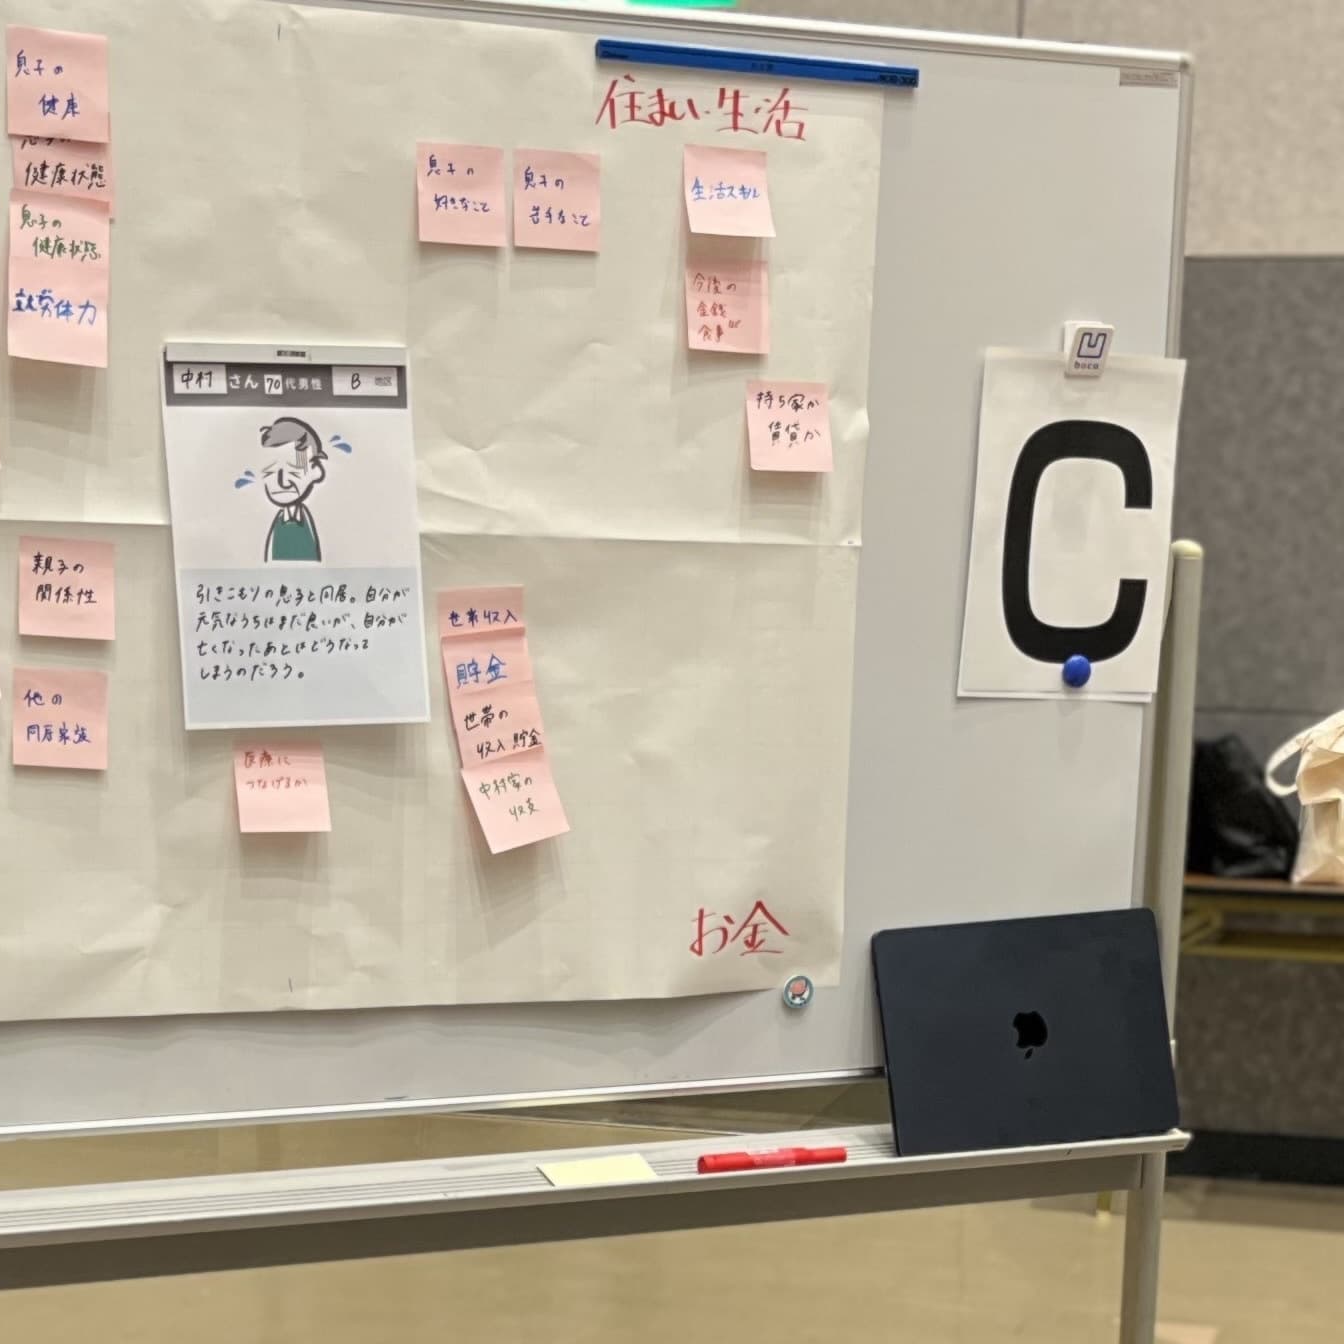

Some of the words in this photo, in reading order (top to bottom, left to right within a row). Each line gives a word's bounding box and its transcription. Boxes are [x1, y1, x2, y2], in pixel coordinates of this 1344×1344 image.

[15, 49, 63, 77] 息子の
[39, 92, 80, 120] 健康
[25, 160, 106, 190] 健康状態
[427, 154, 474, 176] 息子の
[524, 166, 564, 190] 息子の
[691, 176, 760, 201] 生活スキル
[434, 193, 490, 213] 好きなこと
[20, 203, 62, 229] 息子の
[529, 205, 590, 227] 苦手なこと
[693, 272, 737, 294] 今後の
[181, 370, 213, 389] 中村
[229, 374, 258, 390] さん
[266, 376, 281, 393] 70
[756, 390, 819, 412] 持ち家か
[1002, 419, 1153, 664] C
[32, 552, 84, 575] 親子の
[36, 584, 97, 604] 関係性
[200, 662, 305, 681] しまうのだろう。
[456, 654, 507, 689] 貯金
[24, 689, 62, 708] 他の
[463, 704, 509, 731] 世帯の
[479, 772, 533, 800] 中村家の
[689, 900, 790, 958] お金
